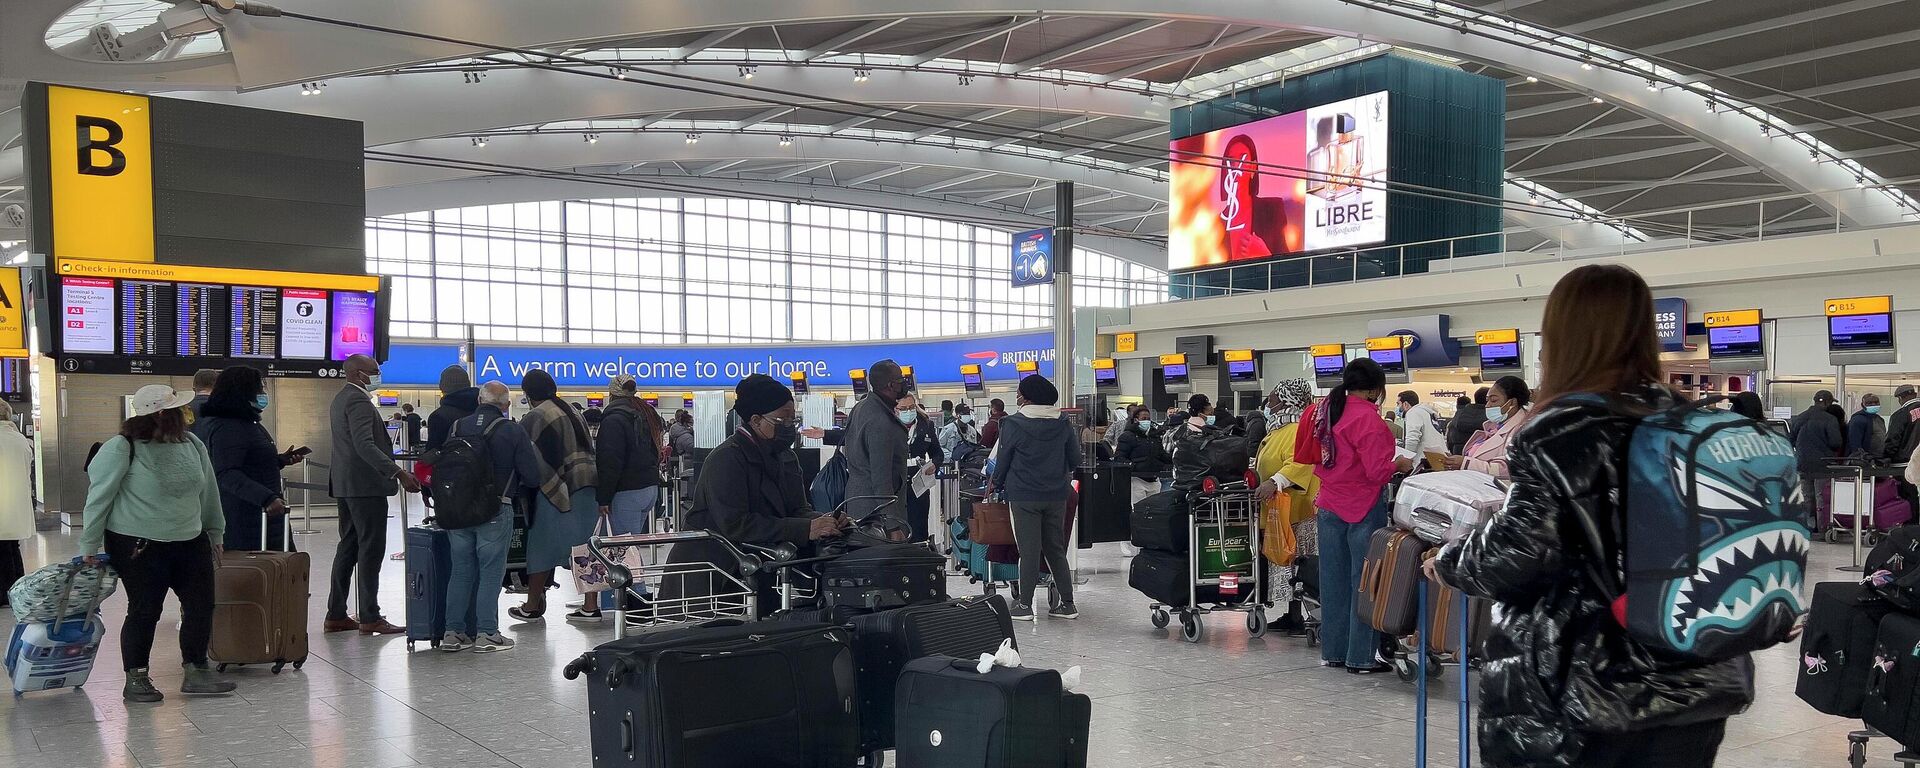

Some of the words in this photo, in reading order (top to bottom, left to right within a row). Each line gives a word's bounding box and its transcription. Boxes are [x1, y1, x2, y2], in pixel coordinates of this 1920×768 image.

[76, 115, 126, 177] B
[1316, 201, 1373, 227] LIBRE
[75, 264, 117, 273] Check-in
[119, 266, 174, 276] information
[1656, 312, 1676, 322] ESS
[1002, 350, 1038, 363] BRITISH
[480, 356, 501, 377] A
[508, 361, 576, 378] warm
[584, 356, 688, 378] welcome
[694, 360, 717, 378] to
[725, 362, 762, 378] our
[768, 356, 831, 378] home.
[1708, 432, 1794, 464] HORNETS
[1208, 538, 1242, 546] Eurpcar
